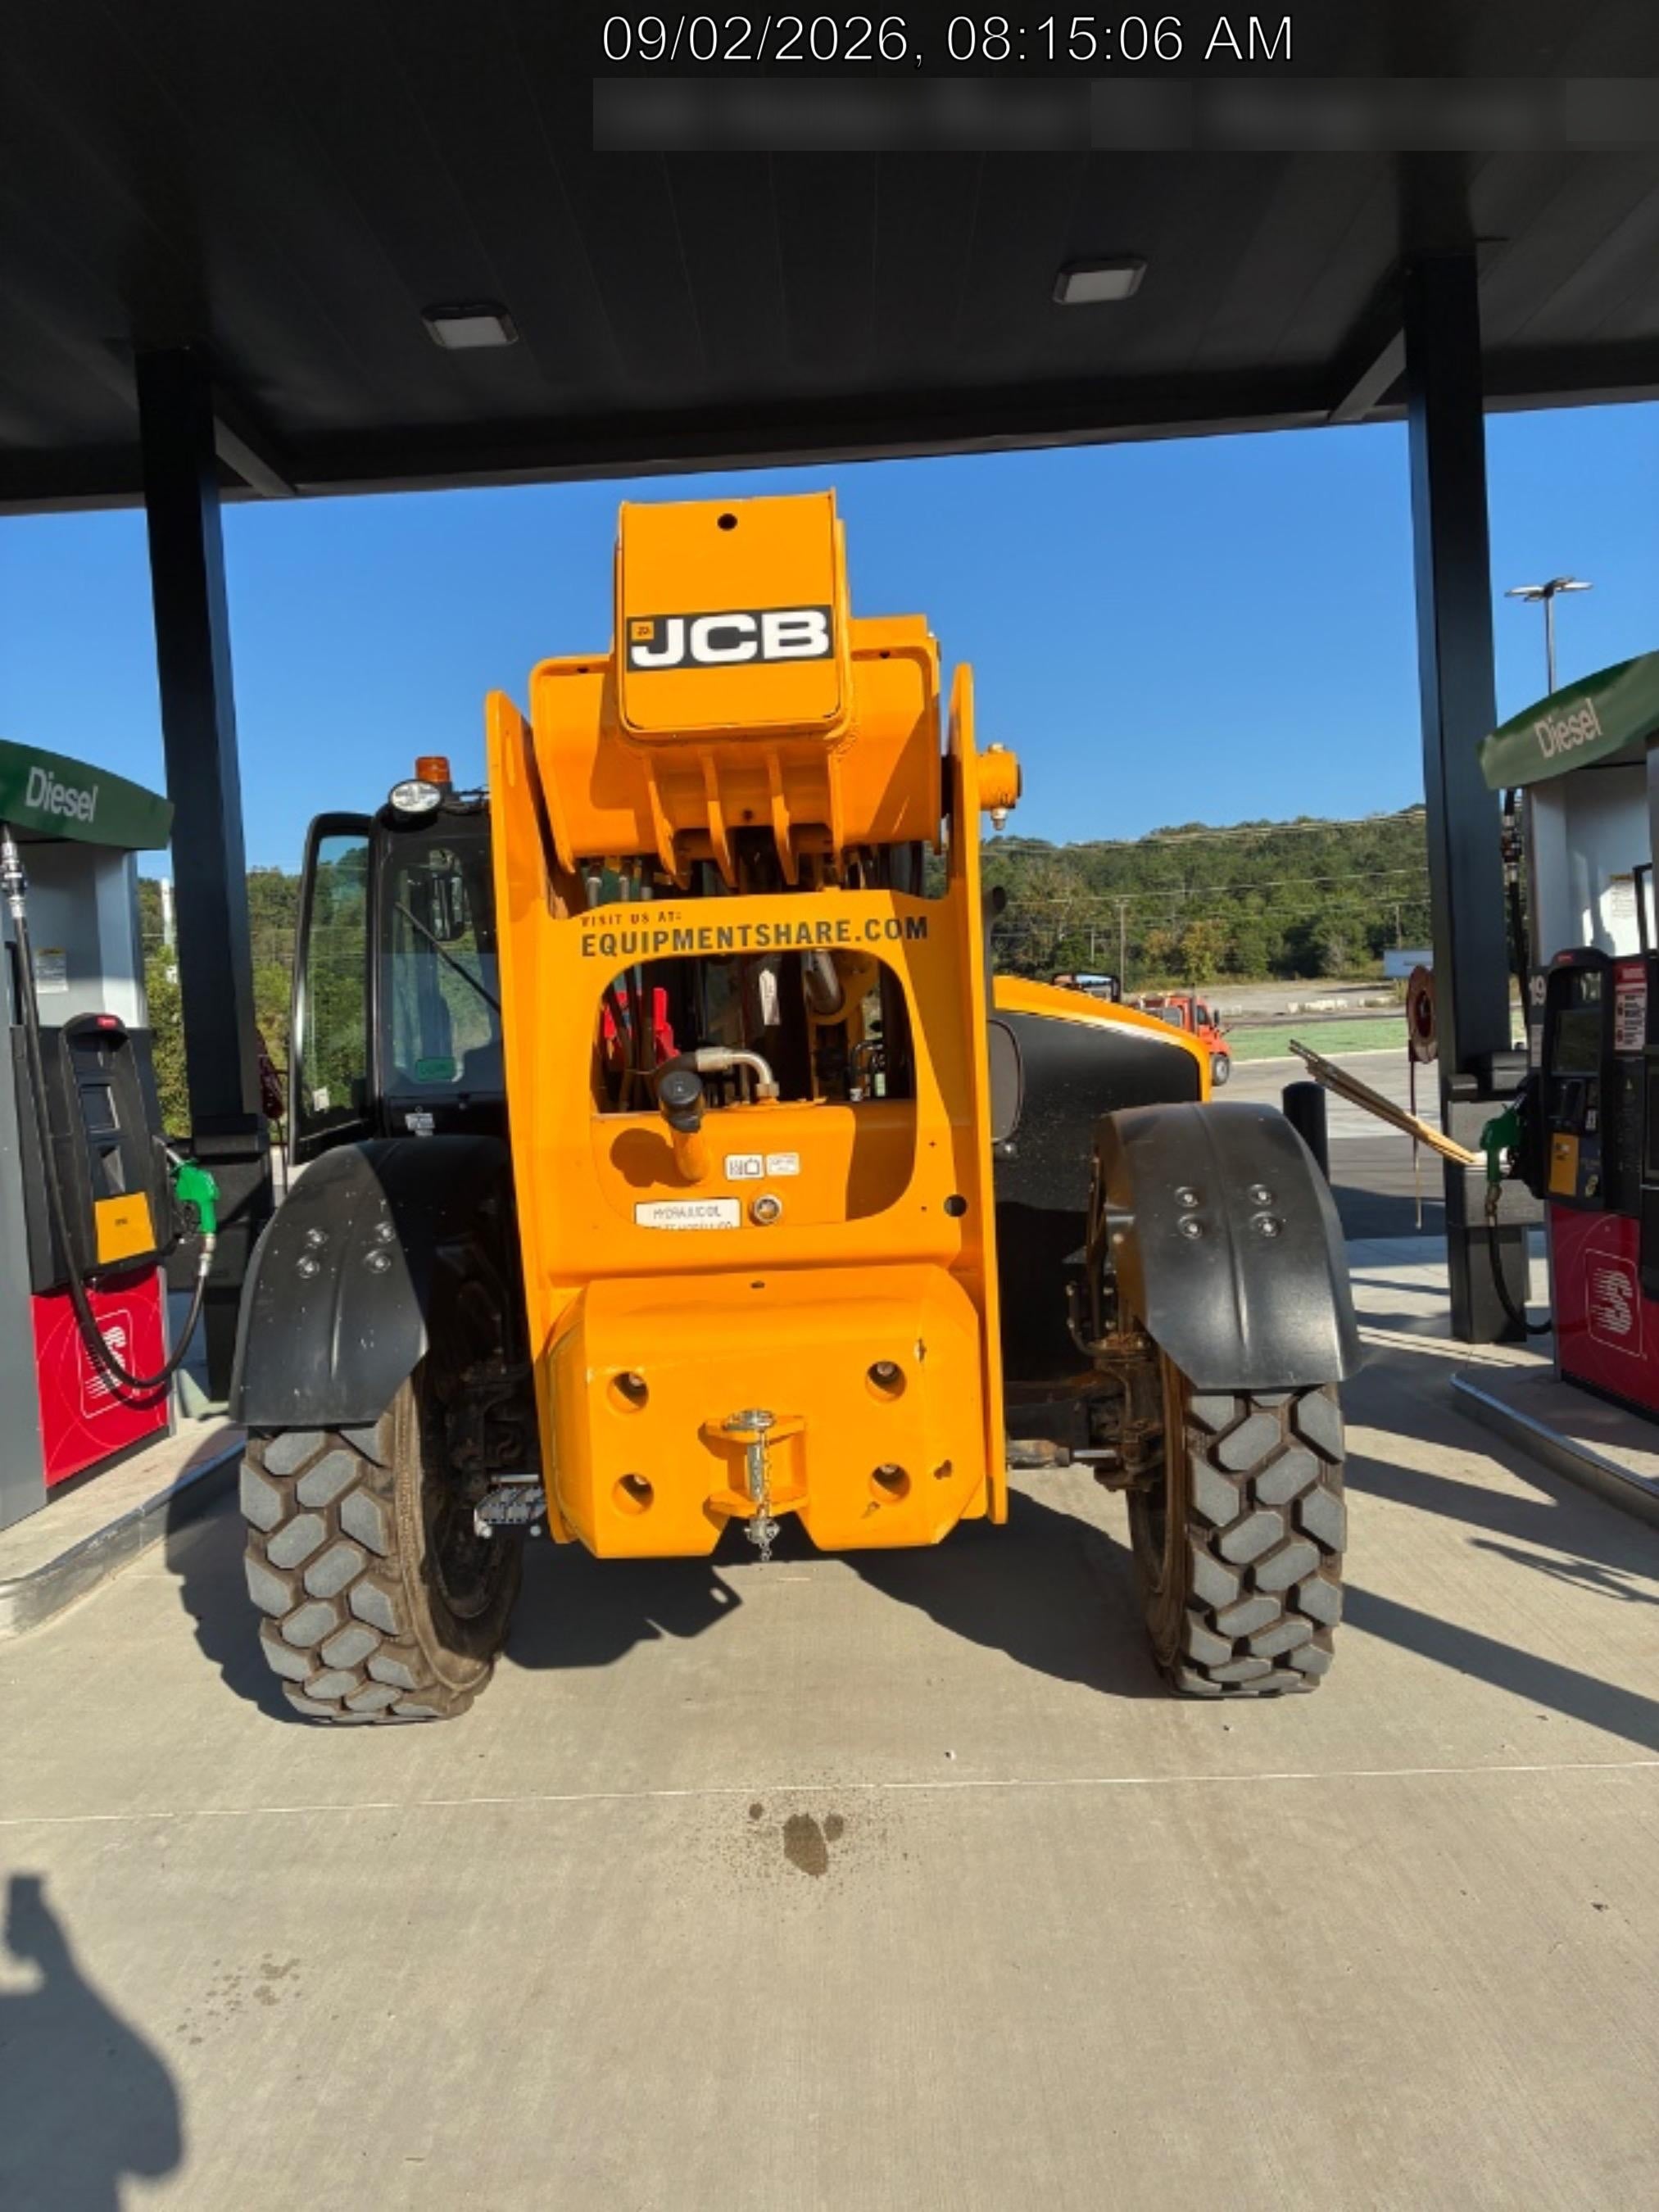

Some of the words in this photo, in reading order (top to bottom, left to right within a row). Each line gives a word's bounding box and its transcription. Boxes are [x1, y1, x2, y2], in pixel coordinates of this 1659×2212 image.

[631, 610, 830, 667] JCB
[1534, 697, 1602, 758] Diesel
[25, 766, 98, 823] Diesel
[580, 913, 622, 927] VISIT
[631, 911, 650, 925] US
[658, 911, 682, 923] AT:
[581, 916, 928, 957] EQUIPMENTSHARE.COM
